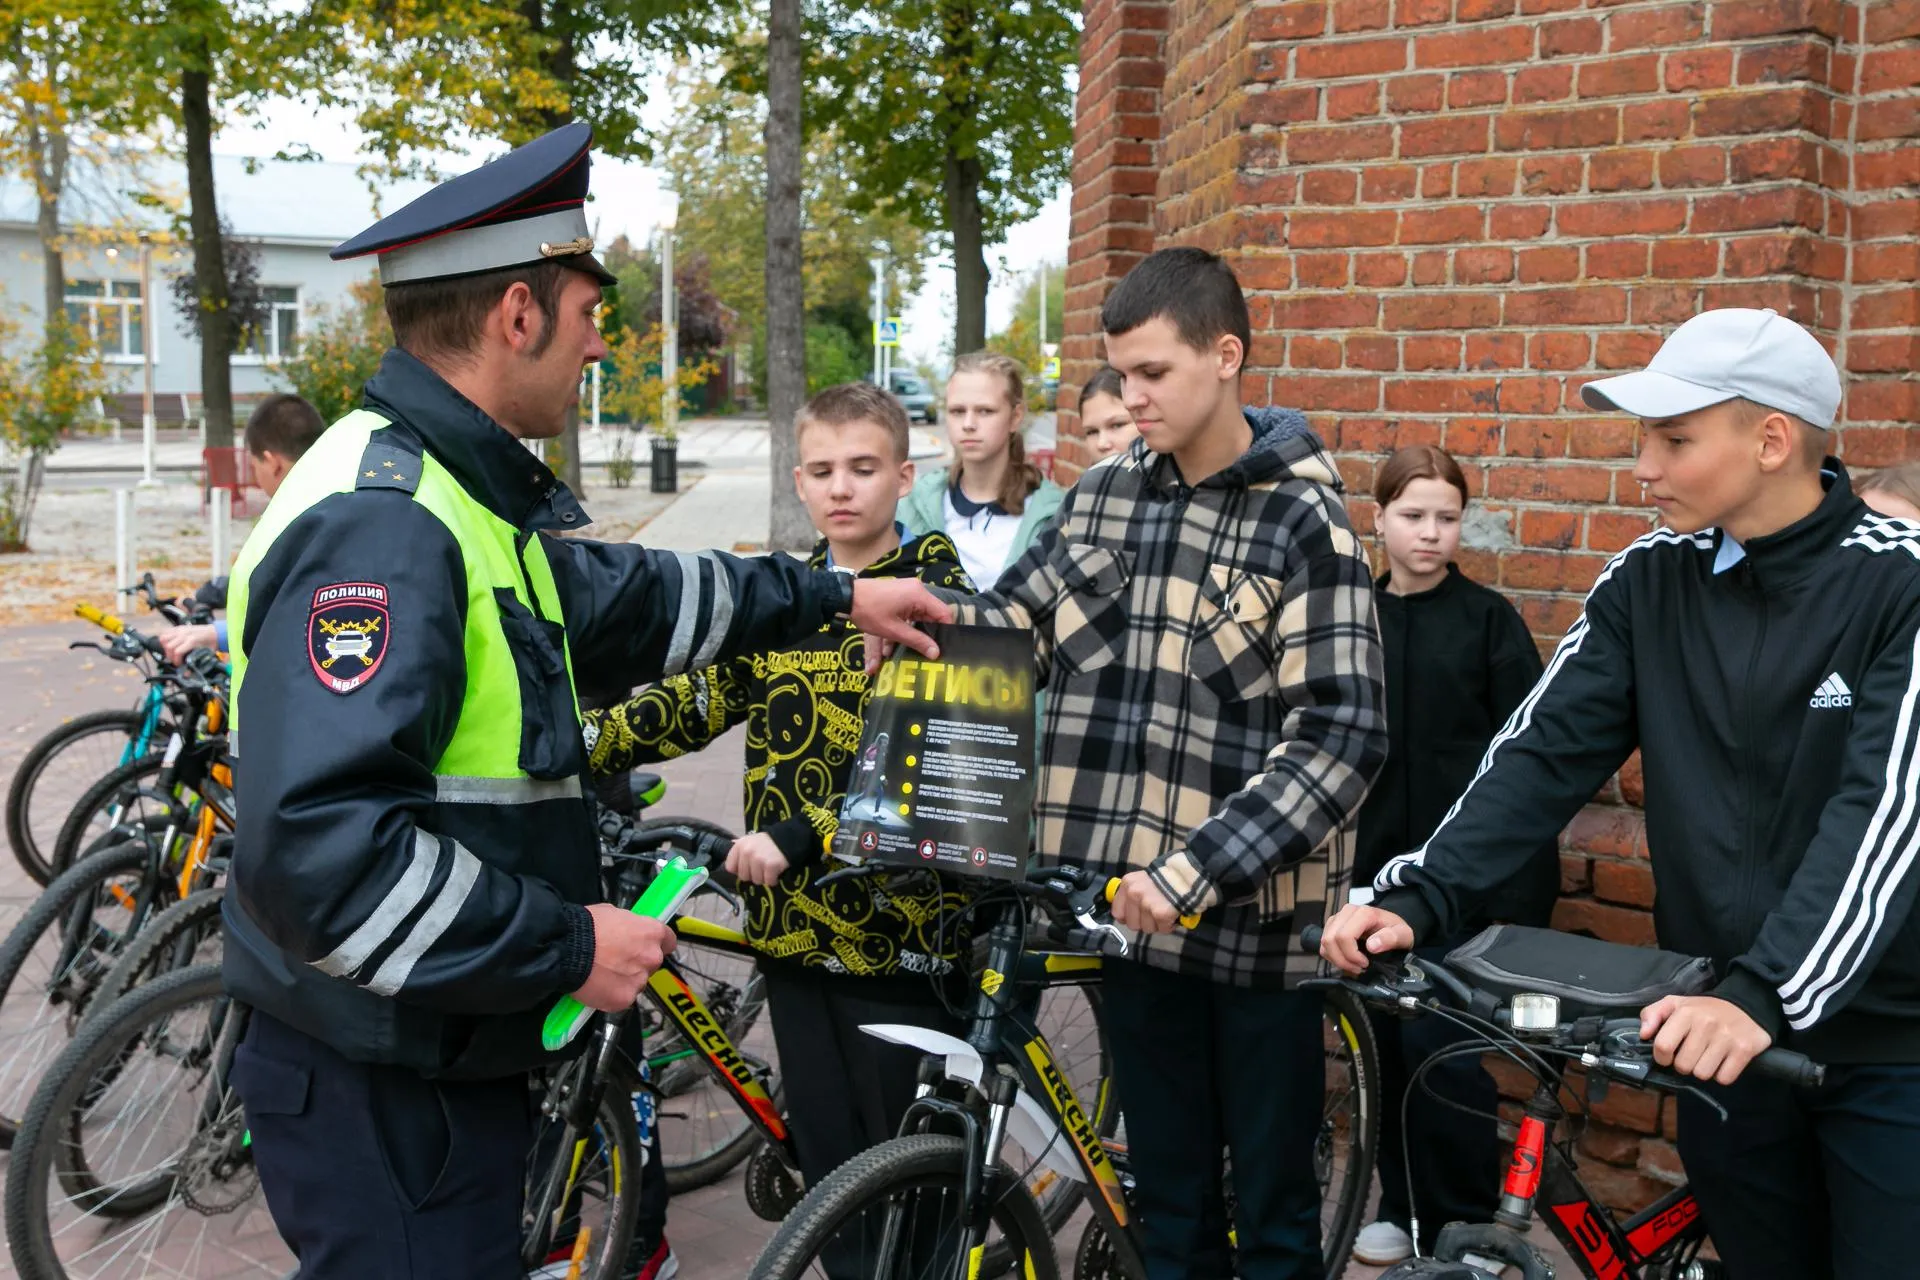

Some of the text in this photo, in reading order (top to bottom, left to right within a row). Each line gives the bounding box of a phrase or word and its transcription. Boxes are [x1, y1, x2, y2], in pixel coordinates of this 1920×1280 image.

[320, 587, 383, 602] ПОЛИЦИЯ
[331, 677, 360, 692] МВД
[1809, 693, 1852, 708] adida
